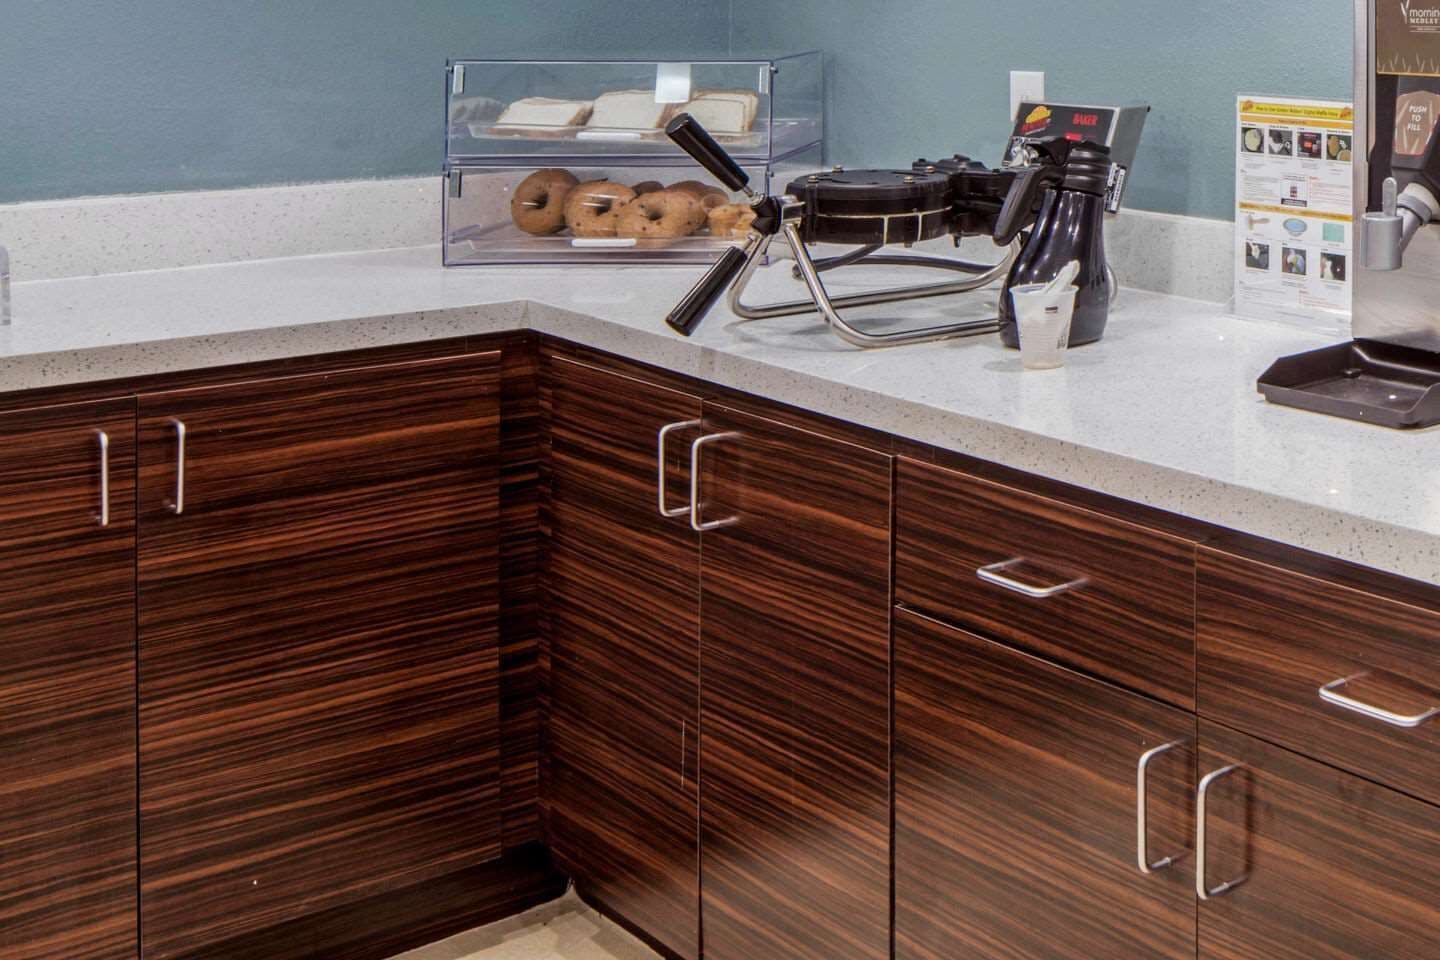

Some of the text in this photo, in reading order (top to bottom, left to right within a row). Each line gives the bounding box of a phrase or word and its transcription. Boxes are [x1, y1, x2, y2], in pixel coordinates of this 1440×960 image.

[1409, 105, 1428, 113] PUSH
[1411, 114, 1421, 123] TO
[1407, 122, 1421, 132] FILL
